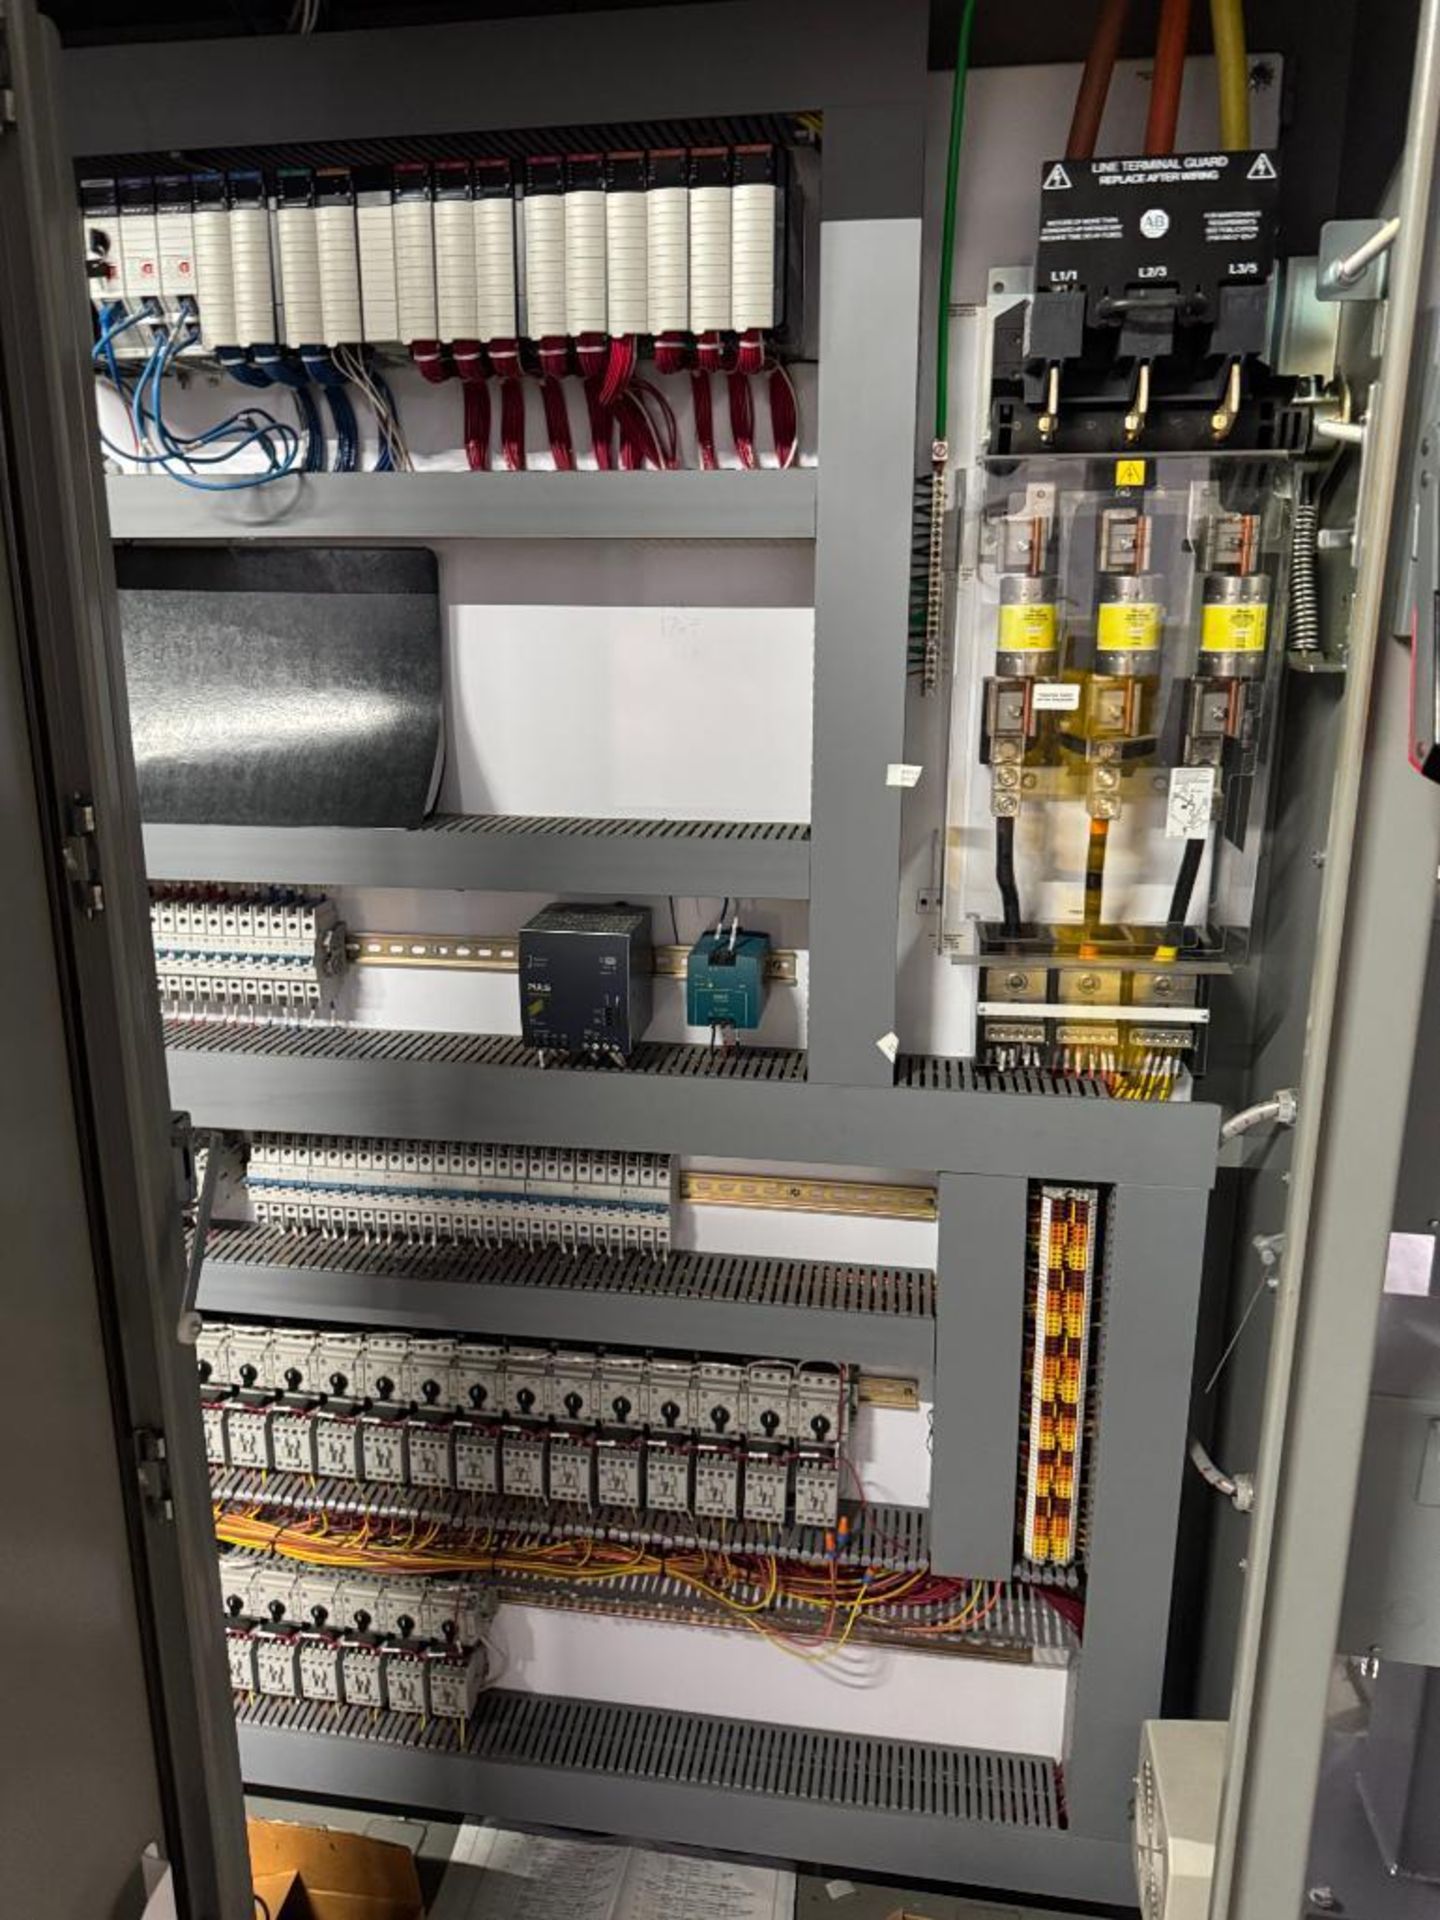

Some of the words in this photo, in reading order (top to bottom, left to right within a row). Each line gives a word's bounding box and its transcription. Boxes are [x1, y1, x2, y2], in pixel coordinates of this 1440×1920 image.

[1092, 161, 1120, 173] LINE
[1122, 158, 1182, 172] TERMINAL
[1183, 155, 1229, 169] GUARD
[1098, 173, 1146, 185] REPLACE
[1147, 171, 1180, 183] AFTER
[1181, 169, 1220, 181] WIRING
